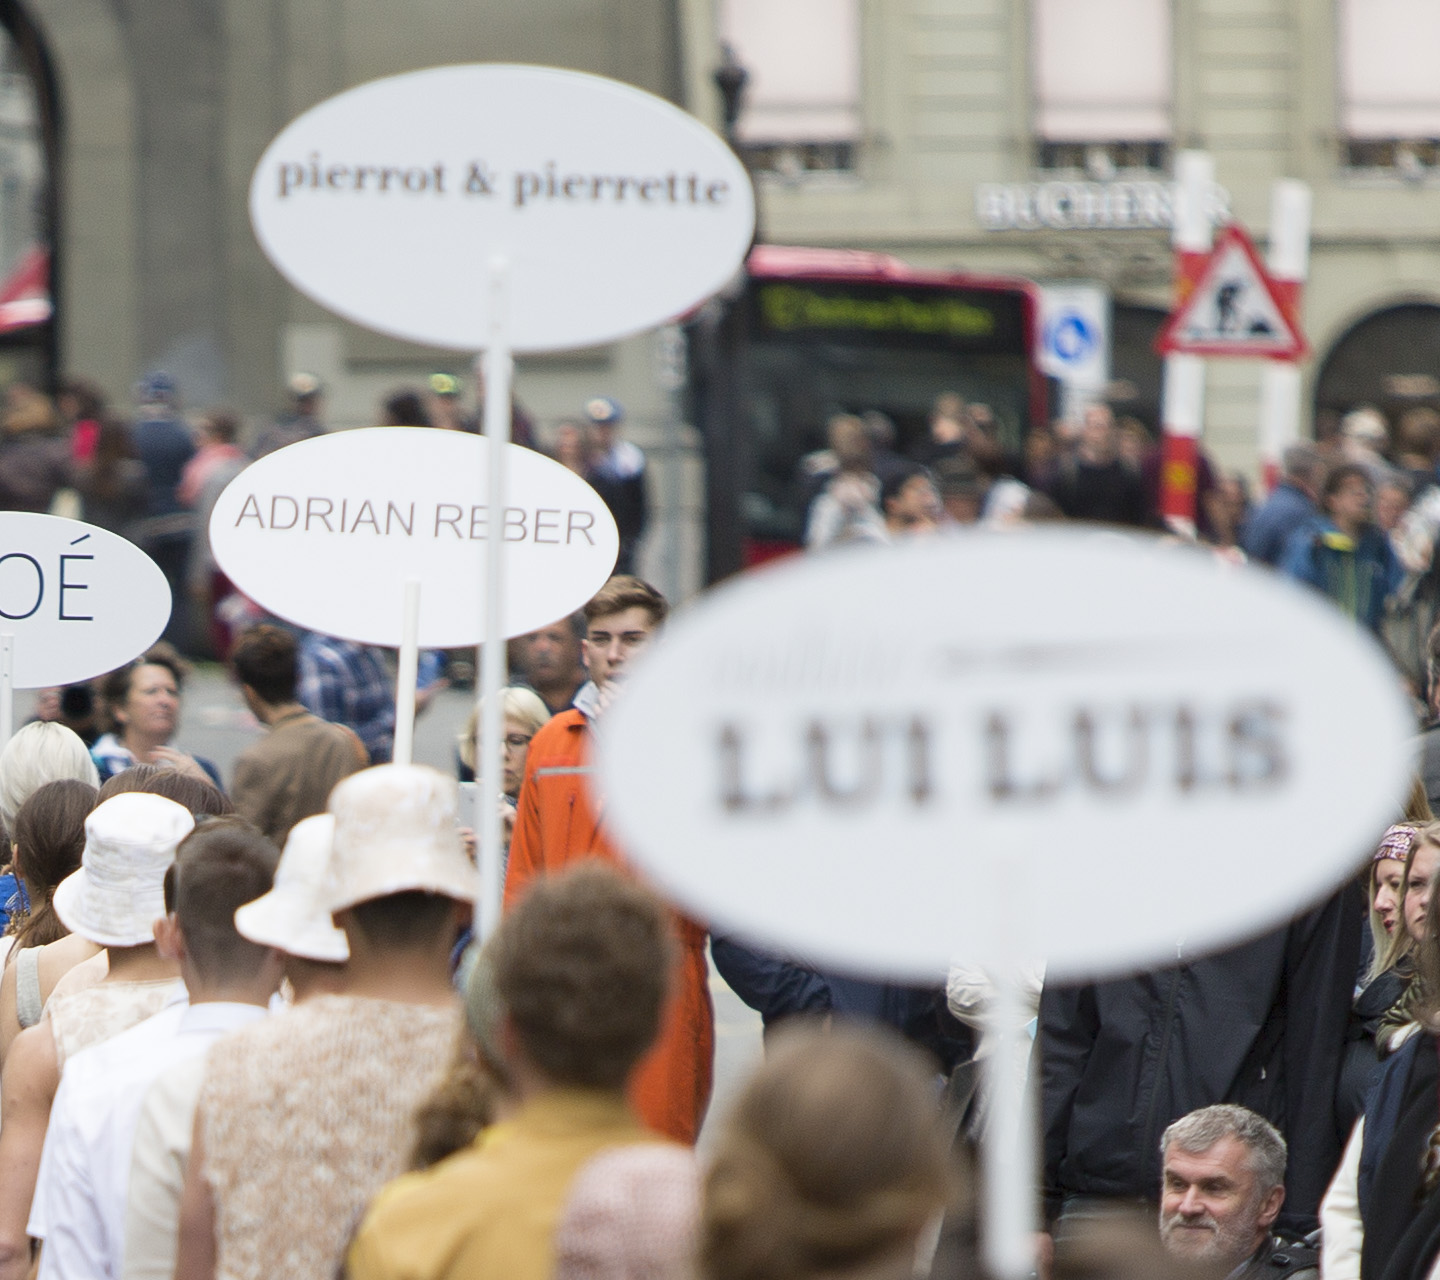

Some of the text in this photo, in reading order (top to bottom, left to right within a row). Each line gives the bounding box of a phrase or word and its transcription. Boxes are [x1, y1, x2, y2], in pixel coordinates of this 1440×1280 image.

[277, 151, 730, 207] pierrot & pierrette
[234, 493, 596, 547] ADRIAN REBER
[712, 694, 1294, 816] LUI LUIS
